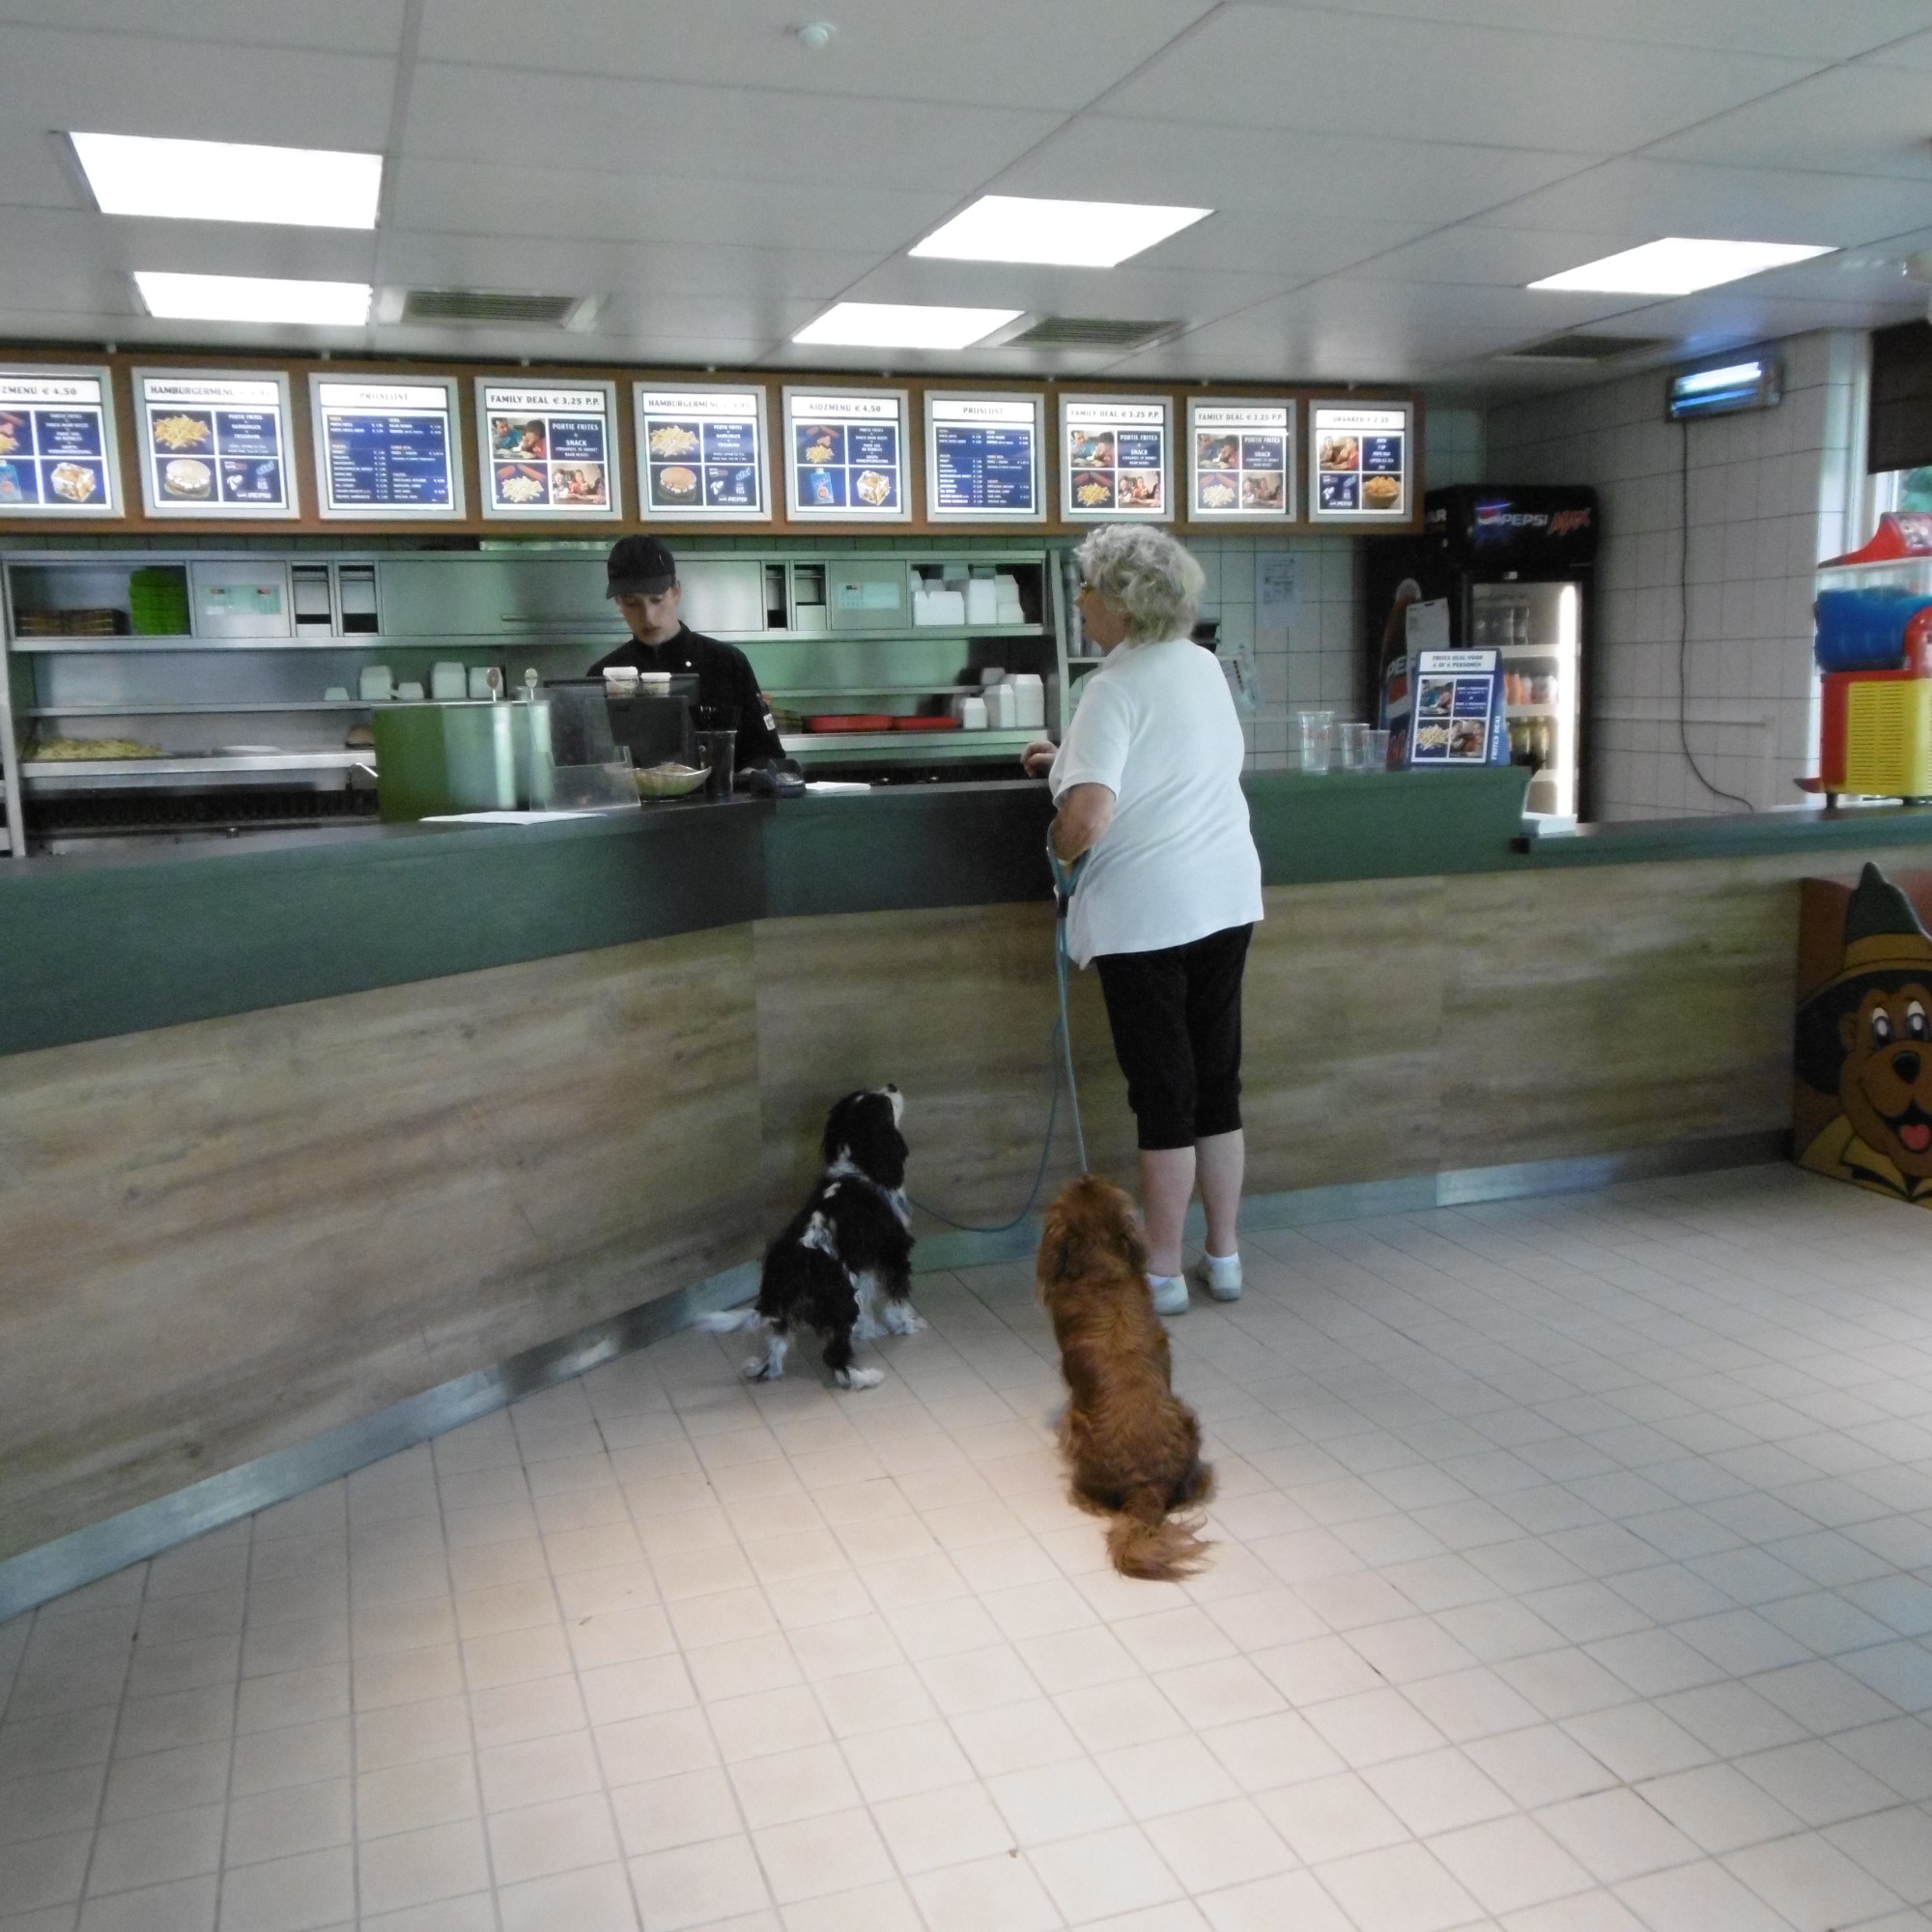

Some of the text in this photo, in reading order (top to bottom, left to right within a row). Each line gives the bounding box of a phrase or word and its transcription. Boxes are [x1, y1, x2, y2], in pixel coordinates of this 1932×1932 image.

[53, 387, 77, 396] 4.50
[491, 395, 523, 404] FAMILY
[585, 397, 600, 406] P.P.
[810, 403, 851, 412] KIDZMENU
[552, 422, 576, 431] PORTIE
[1500, 513, 1548, 526] PEPSI
[1491, 735, 1499, 760] FRITES
